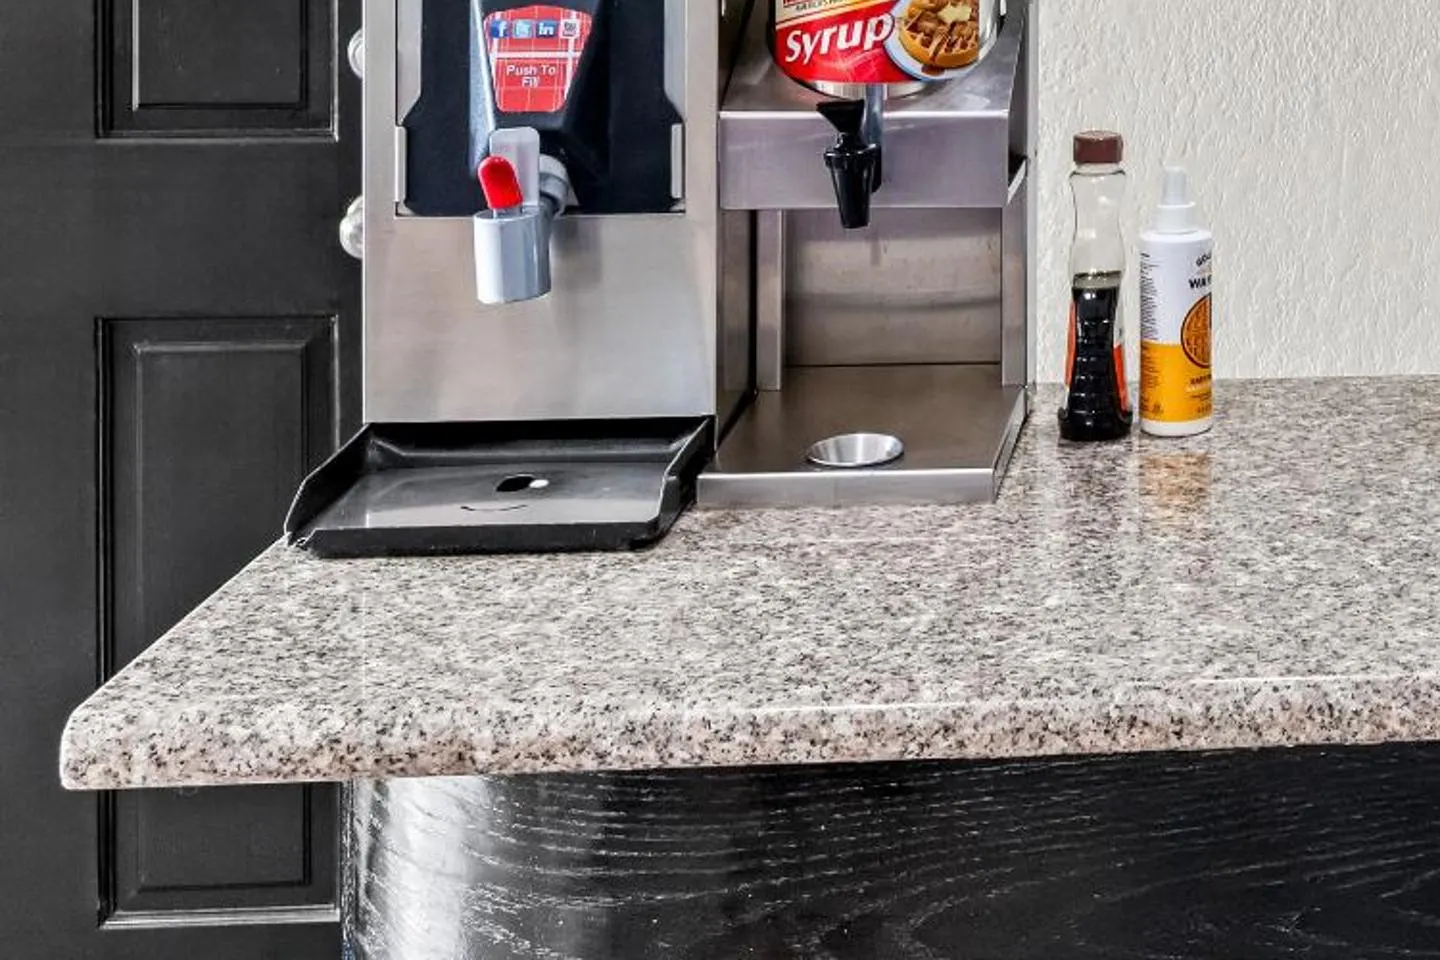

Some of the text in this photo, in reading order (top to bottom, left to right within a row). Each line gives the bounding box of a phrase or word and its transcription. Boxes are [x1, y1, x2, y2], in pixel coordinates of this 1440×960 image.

[785, 11, 894, 65] Syrup
[506, 64, 557, 76] Push To
[521, 76, 540, 88] Fill
